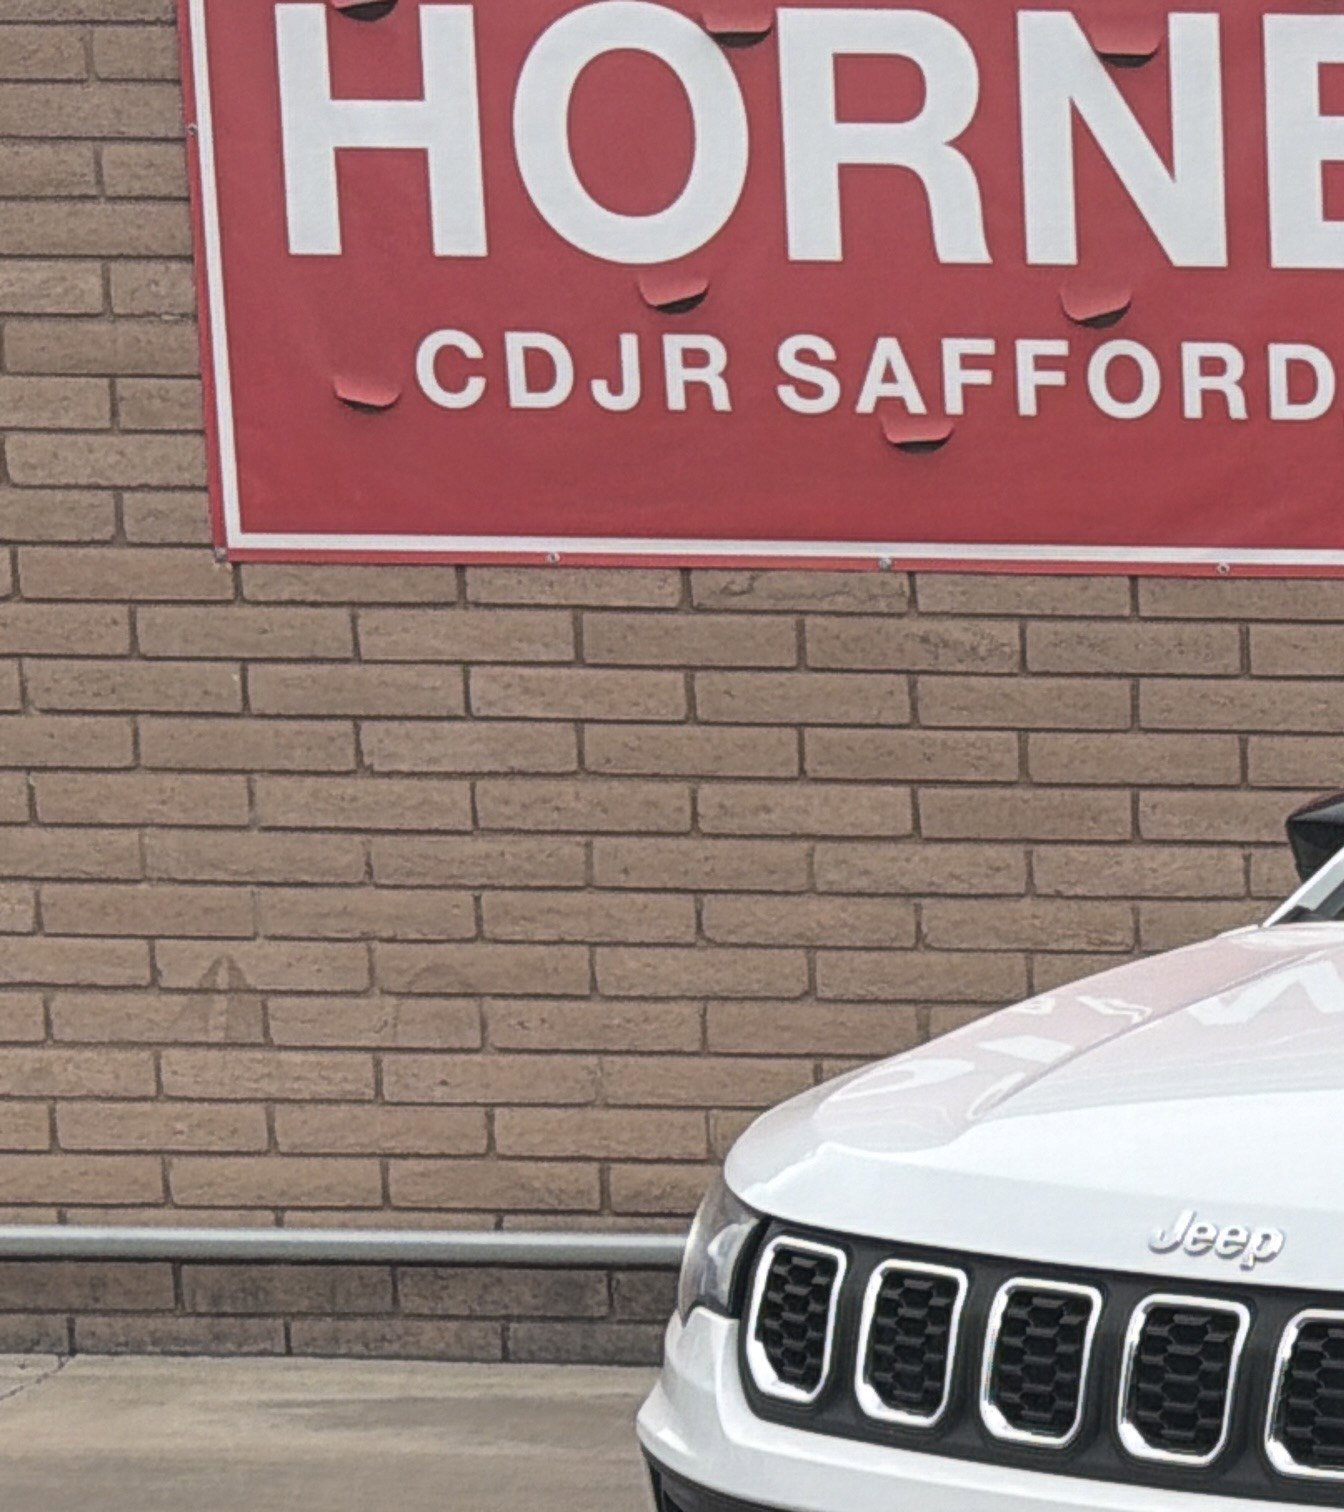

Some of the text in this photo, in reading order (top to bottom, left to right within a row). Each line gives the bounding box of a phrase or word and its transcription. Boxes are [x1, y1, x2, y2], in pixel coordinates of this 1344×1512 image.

[416, 329, 1336, 420] CDJR SAFFORD
[1148, 1208, 1285, 1271] Jeep
